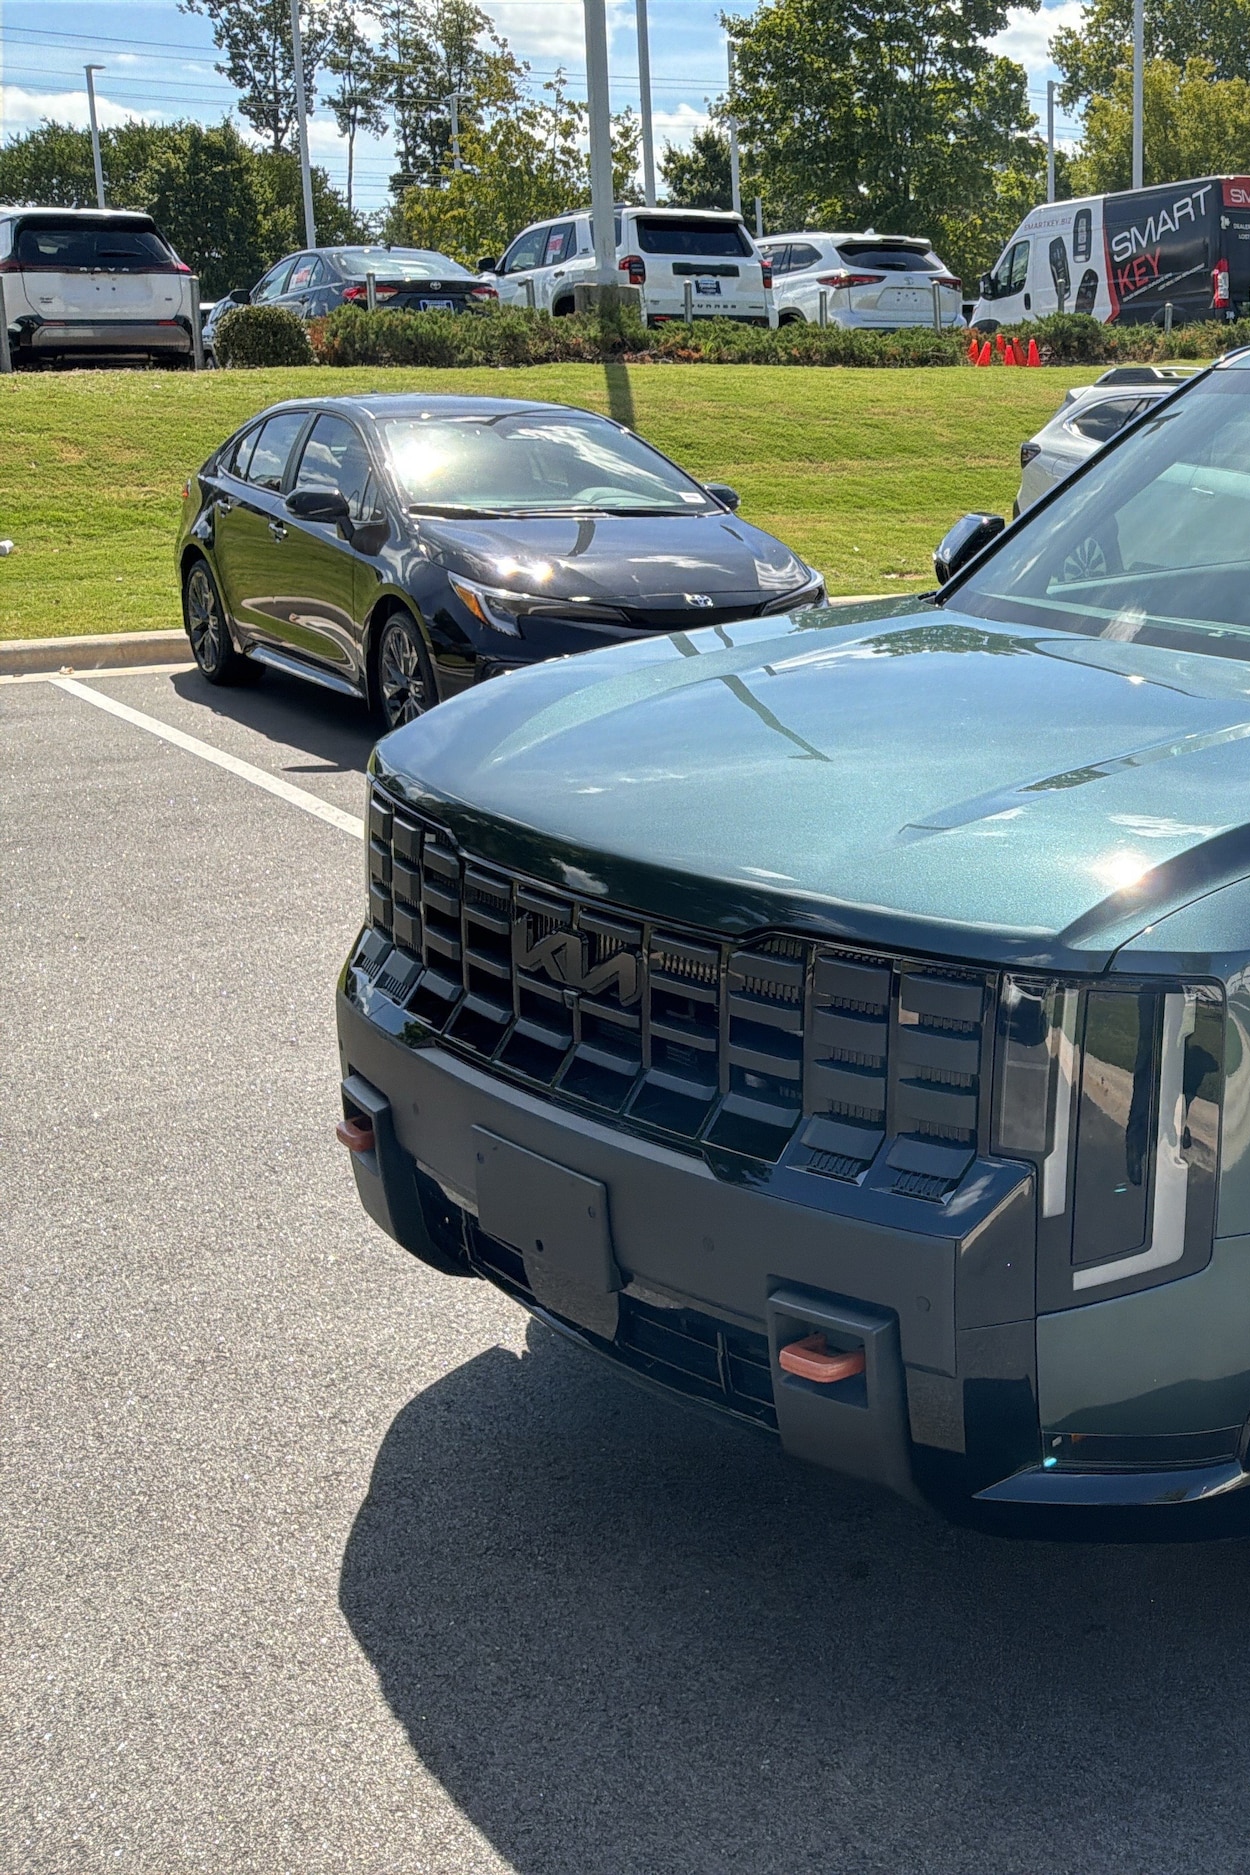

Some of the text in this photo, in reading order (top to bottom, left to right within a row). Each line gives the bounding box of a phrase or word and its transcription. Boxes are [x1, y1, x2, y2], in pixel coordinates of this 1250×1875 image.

[1024, 217, 1072, 231] SMARTKEY.BIZ
[1112, 184, 1212, 262] SMART
[1117, 247, 1161, 295] KEY
[511, 913, 643, 1007] KIA
